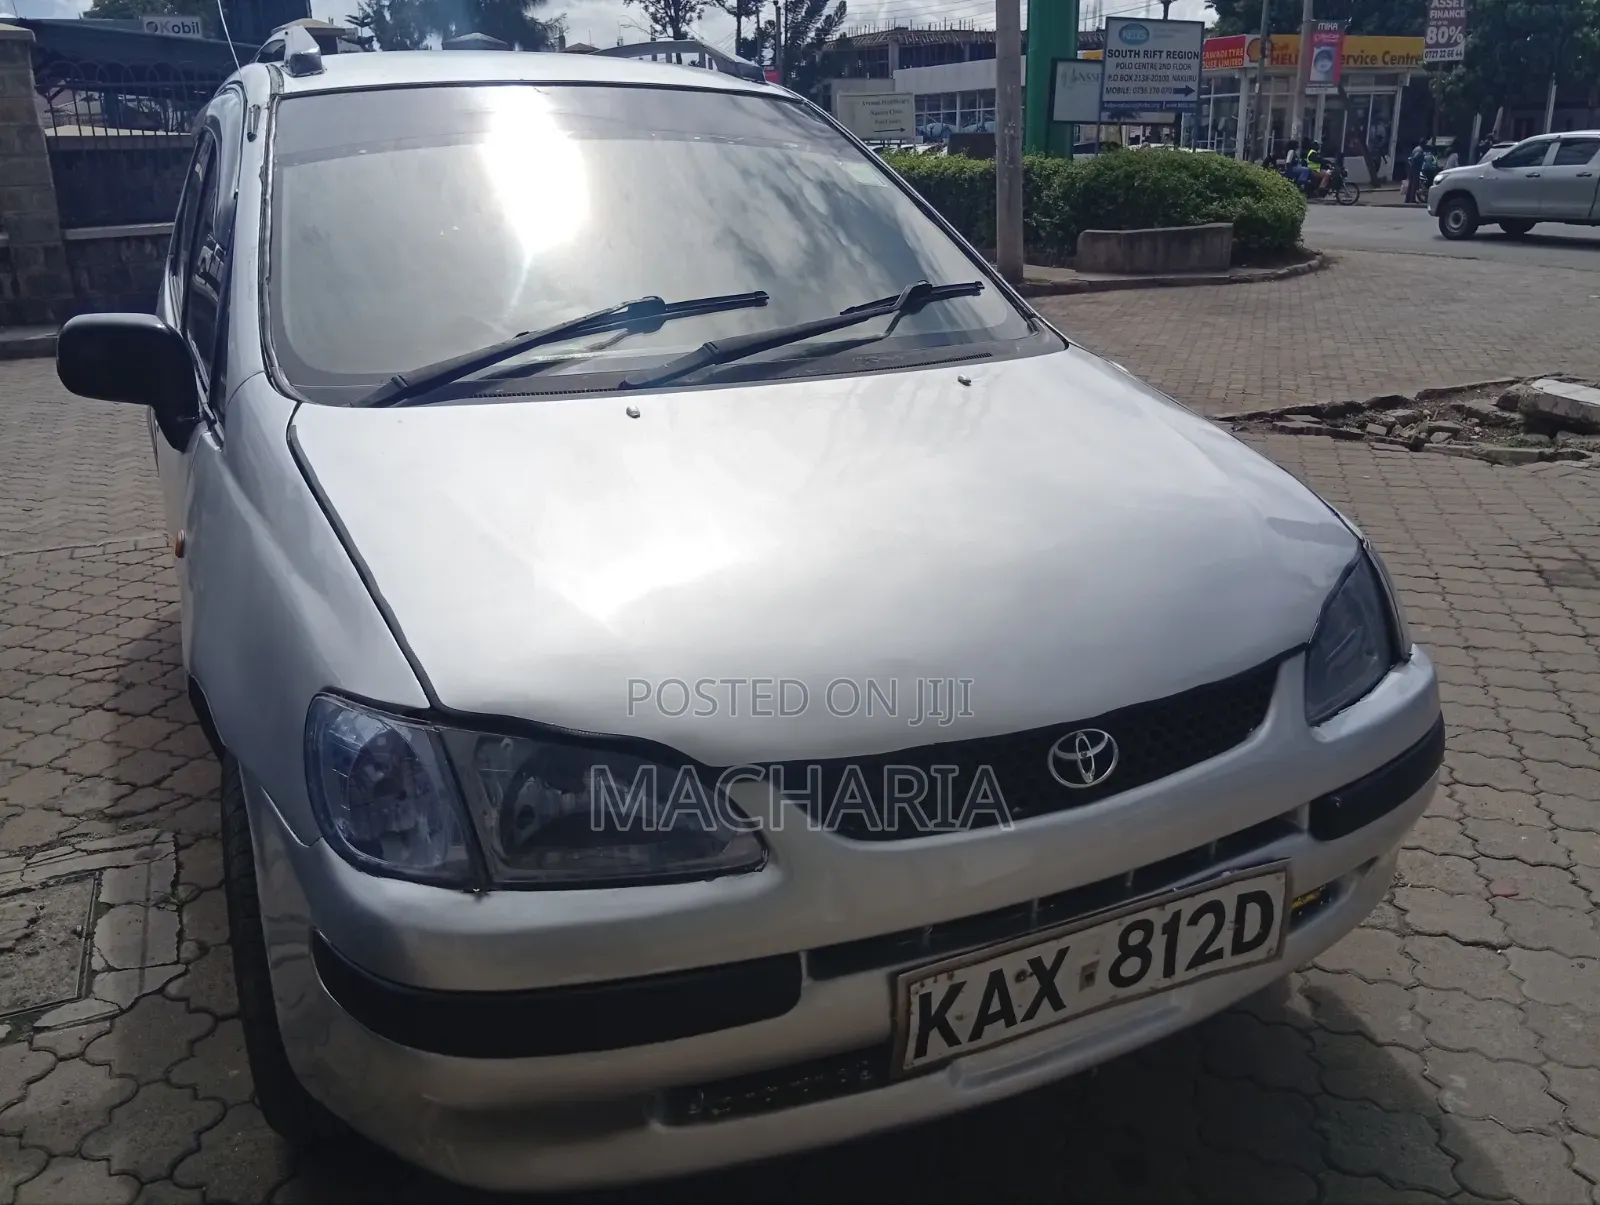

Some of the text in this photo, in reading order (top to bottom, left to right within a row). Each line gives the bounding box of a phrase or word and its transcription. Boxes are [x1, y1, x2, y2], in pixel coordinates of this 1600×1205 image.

[1430, 0, 1465, 8] ASSET
[1430, 9, 1466, 18] FINANCE
[1426, 26, 1464, 44] 80%
[1107, 49, 1200, 60] SOUTH RIFT REGION
[1228, 47, 1244, 57] TYRE
[1340, 50, 1378, 65] ervice
[1115, 62, 1192, 71] POLO CENTRE 2ND FLOOR
[1218, 58, 1243, 68] LIMITED
[1120, 74, 1133, 82] BOX
[1172, 75, 1198, 83] NAKURU
[1105, 87, 1131, 95] MOBILE:
[913, 889, 1275, 1059] KAX 812D
